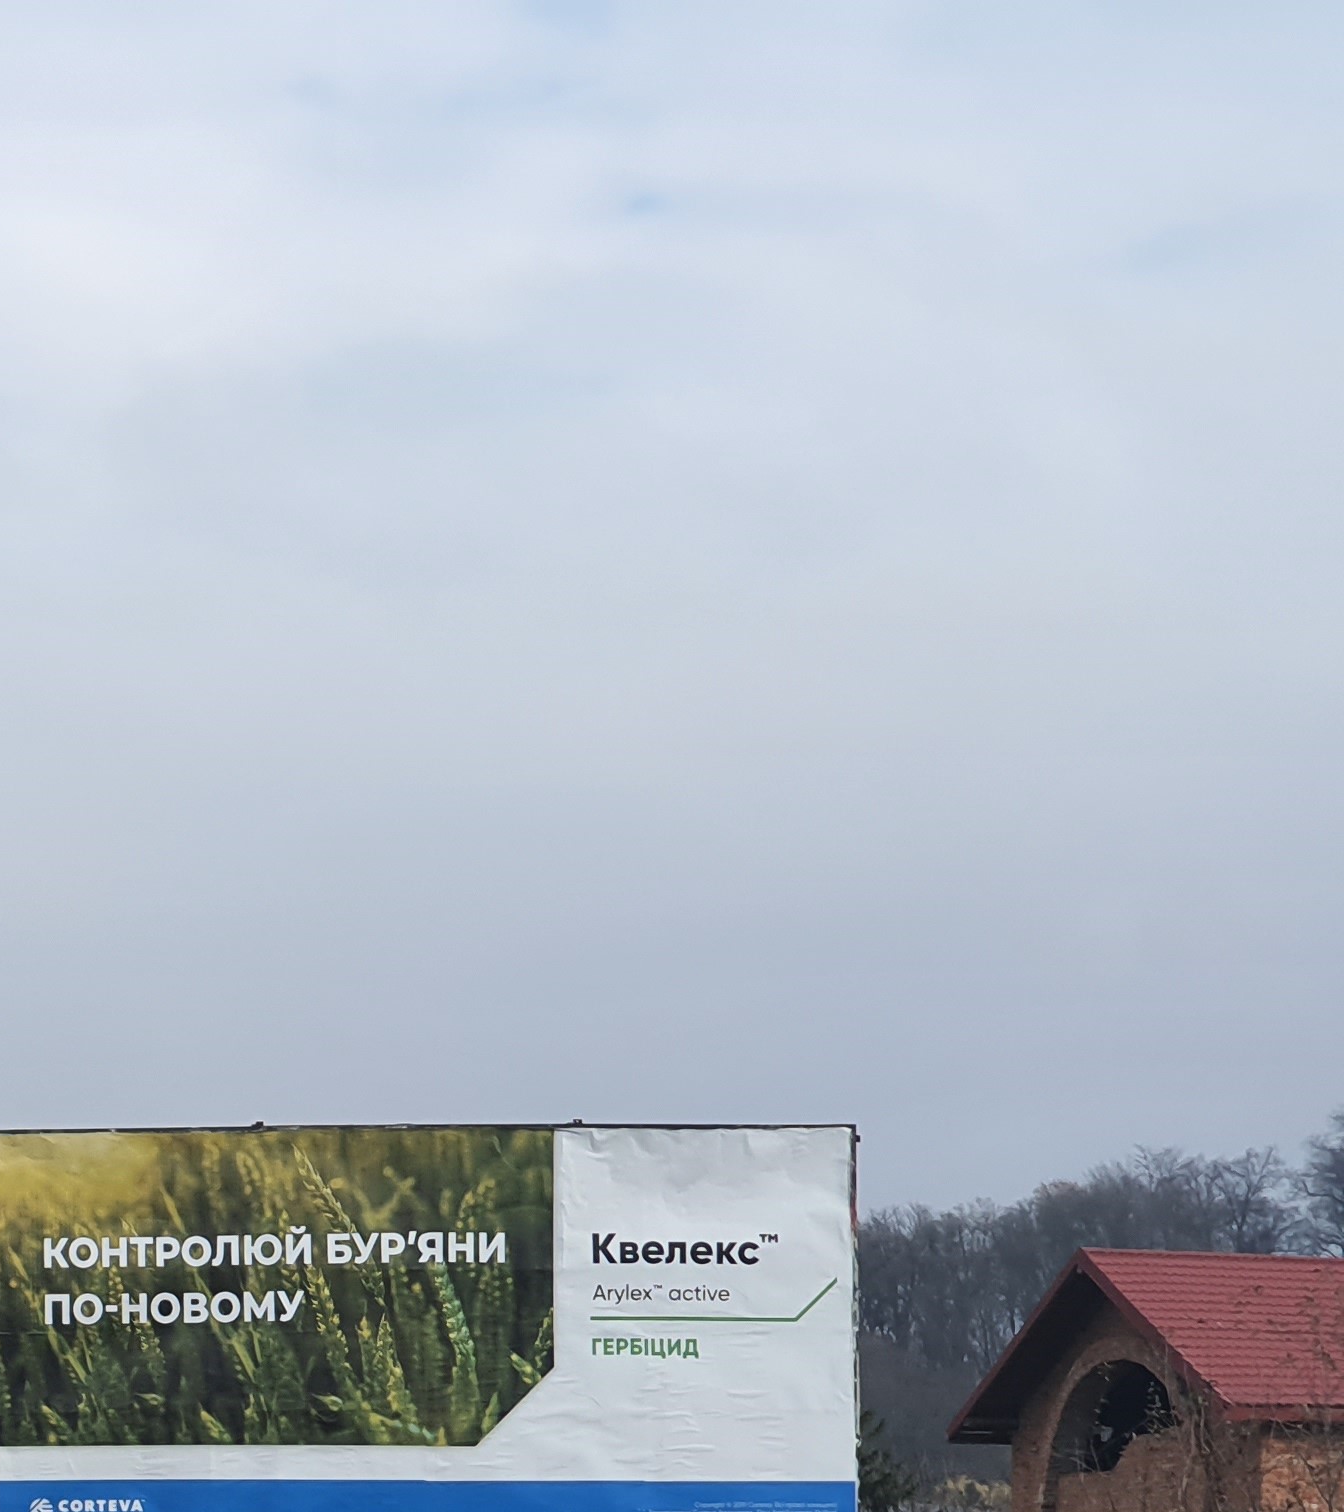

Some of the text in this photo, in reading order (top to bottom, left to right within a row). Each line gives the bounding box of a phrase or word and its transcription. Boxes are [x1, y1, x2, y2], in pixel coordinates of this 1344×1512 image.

[42, 1225, 507, 1269] КОНТРОЛЮЙ БУР'ЯНИ
[668, 1285, 730, 1302] active
[44, 1290, 304, 1325] ПО-НОВОМУ
[592, 1338, 699, 1359] ГЕРБІЦИД
[58, 1499, 144, 1512] CORTEVA
